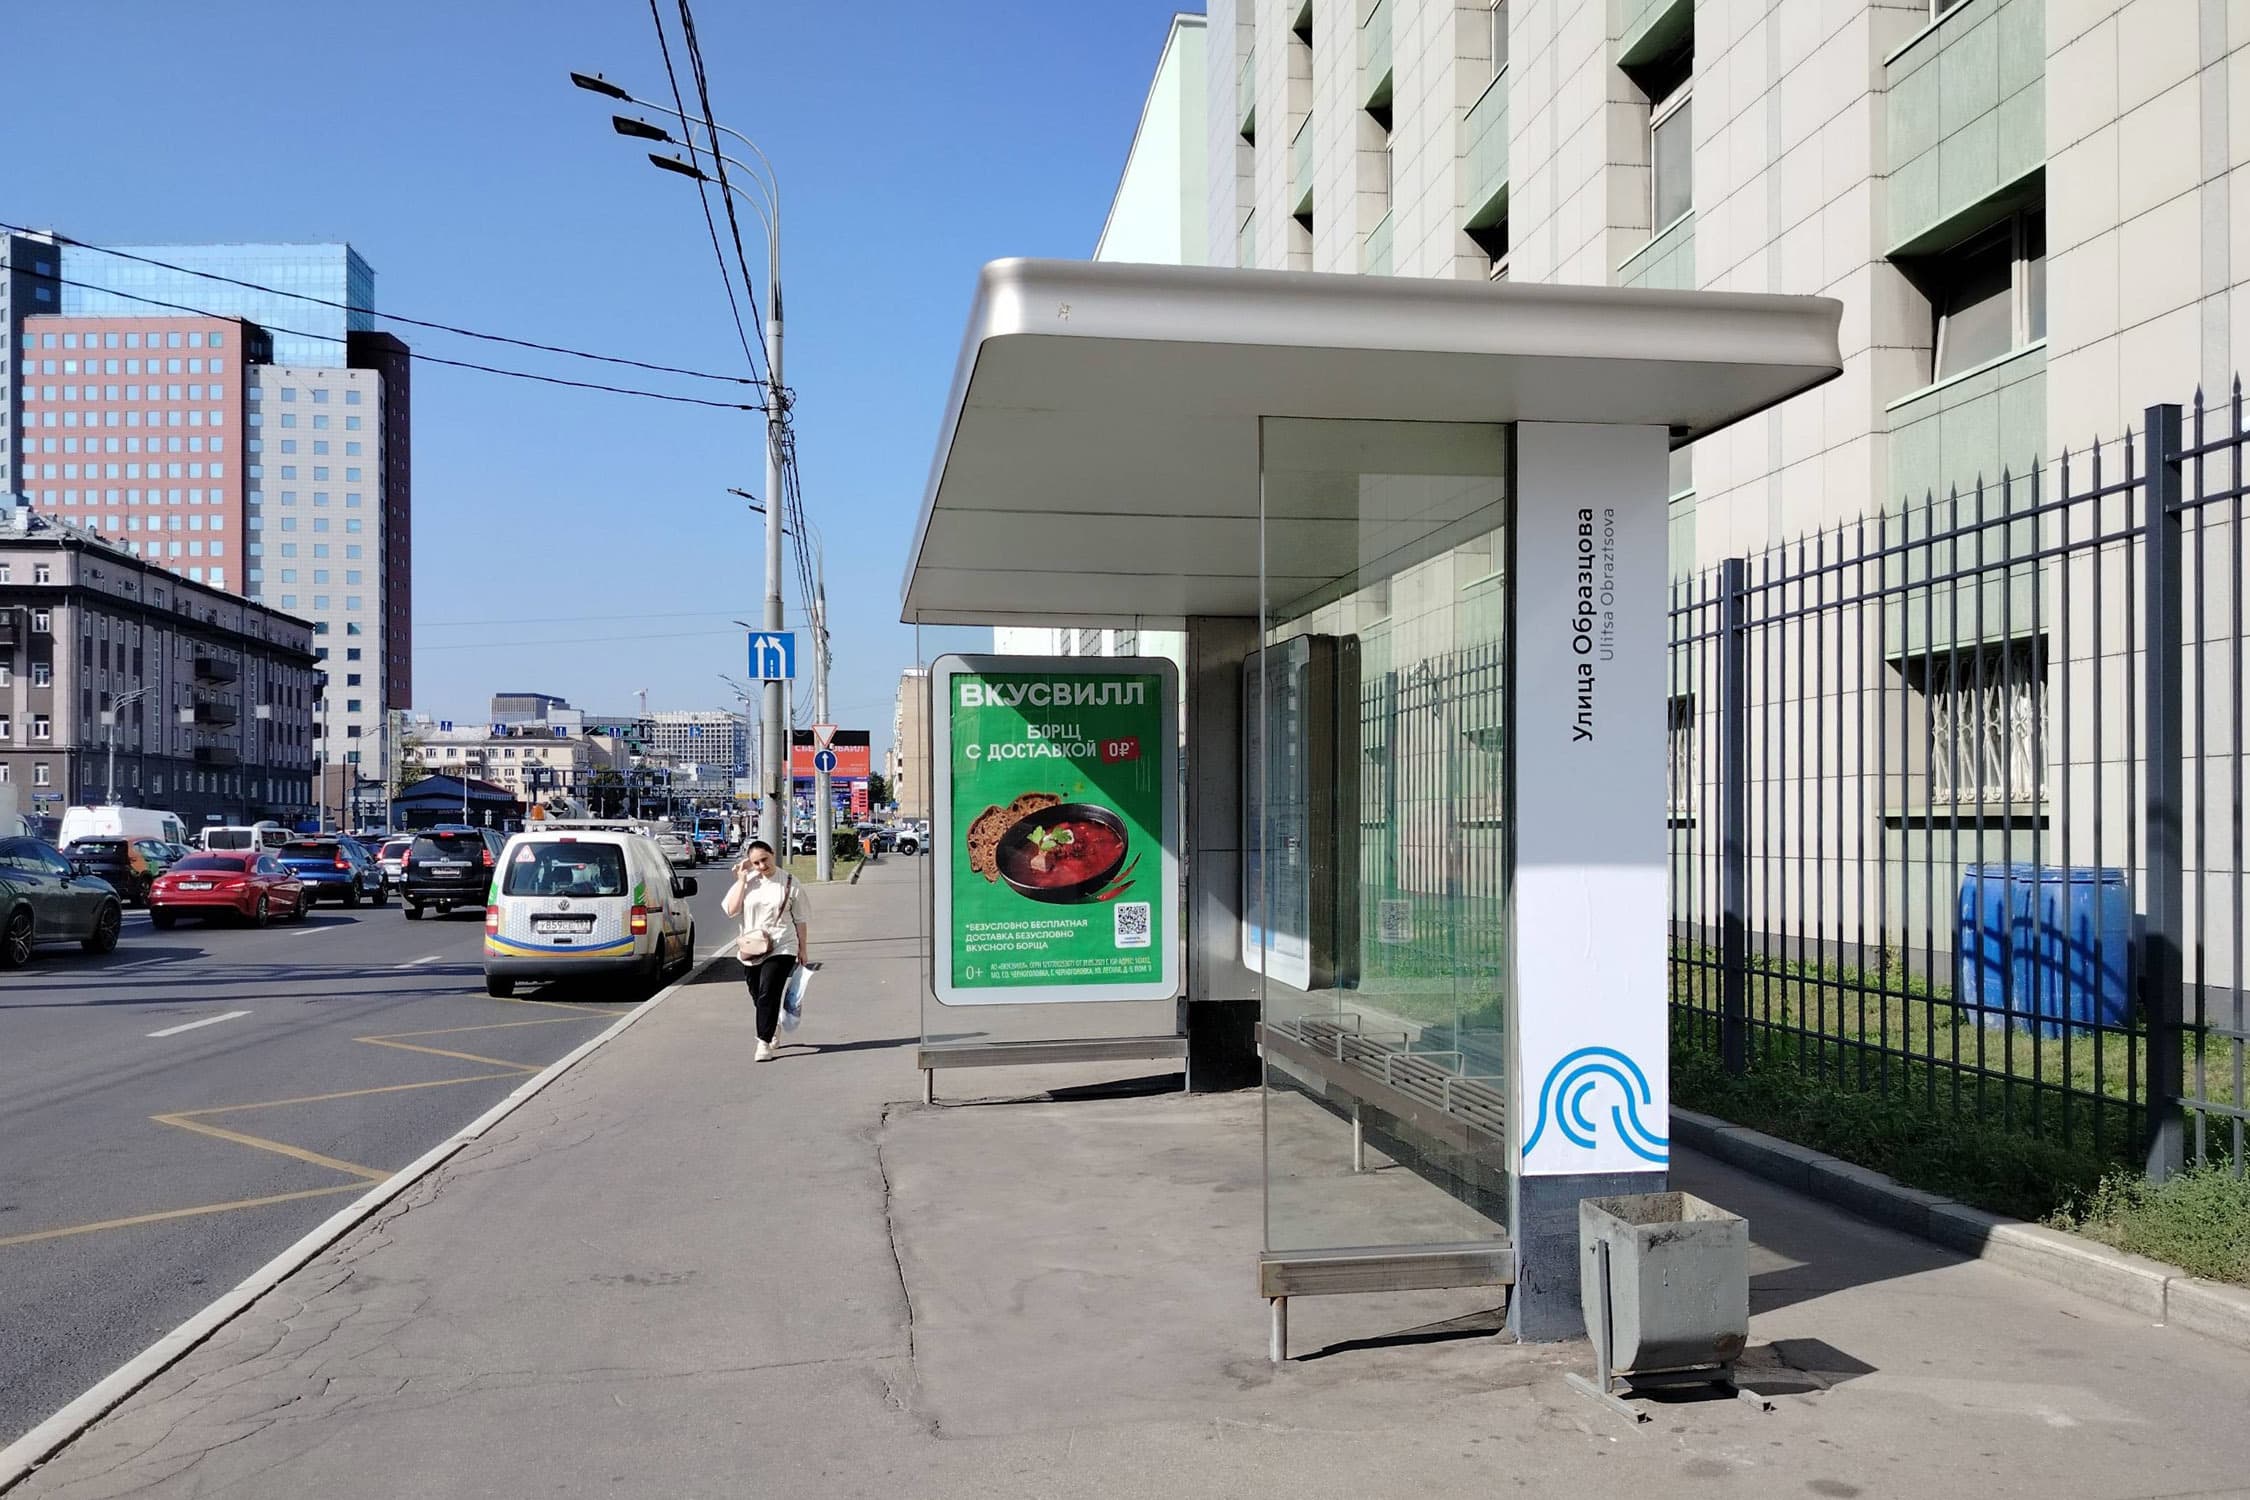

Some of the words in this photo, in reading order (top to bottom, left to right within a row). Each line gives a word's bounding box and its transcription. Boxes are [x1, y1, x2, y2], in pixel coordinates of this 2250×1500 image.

[1600, 508, 1614, 606] Obraztsova
[1572, 508, 1597, 655] Образцова
[1600, 611, 1614, 661] Ulitsa
[960, 682, 1144, 707] ВКУСВИЛЛ
[1572, 663, 1595, 742] Улица
[1027, 724, 1082, 741] БОРЩ
[987, 740, 1096, 762] ДОСТАВКОЙ
[1030, 920, 1088, 928] БЕСПЛАТНАЯ
[966, 932, 1014, 942] ДОСТАВКА
[1016, 930, 1074, 940] БЕЗУСЛОВНО
[966, 943, 1014, 952] ВКУСНОГО
[1016, 942, 1048, 951] БОРЩА
[966, 966, 983, 980] 0+
